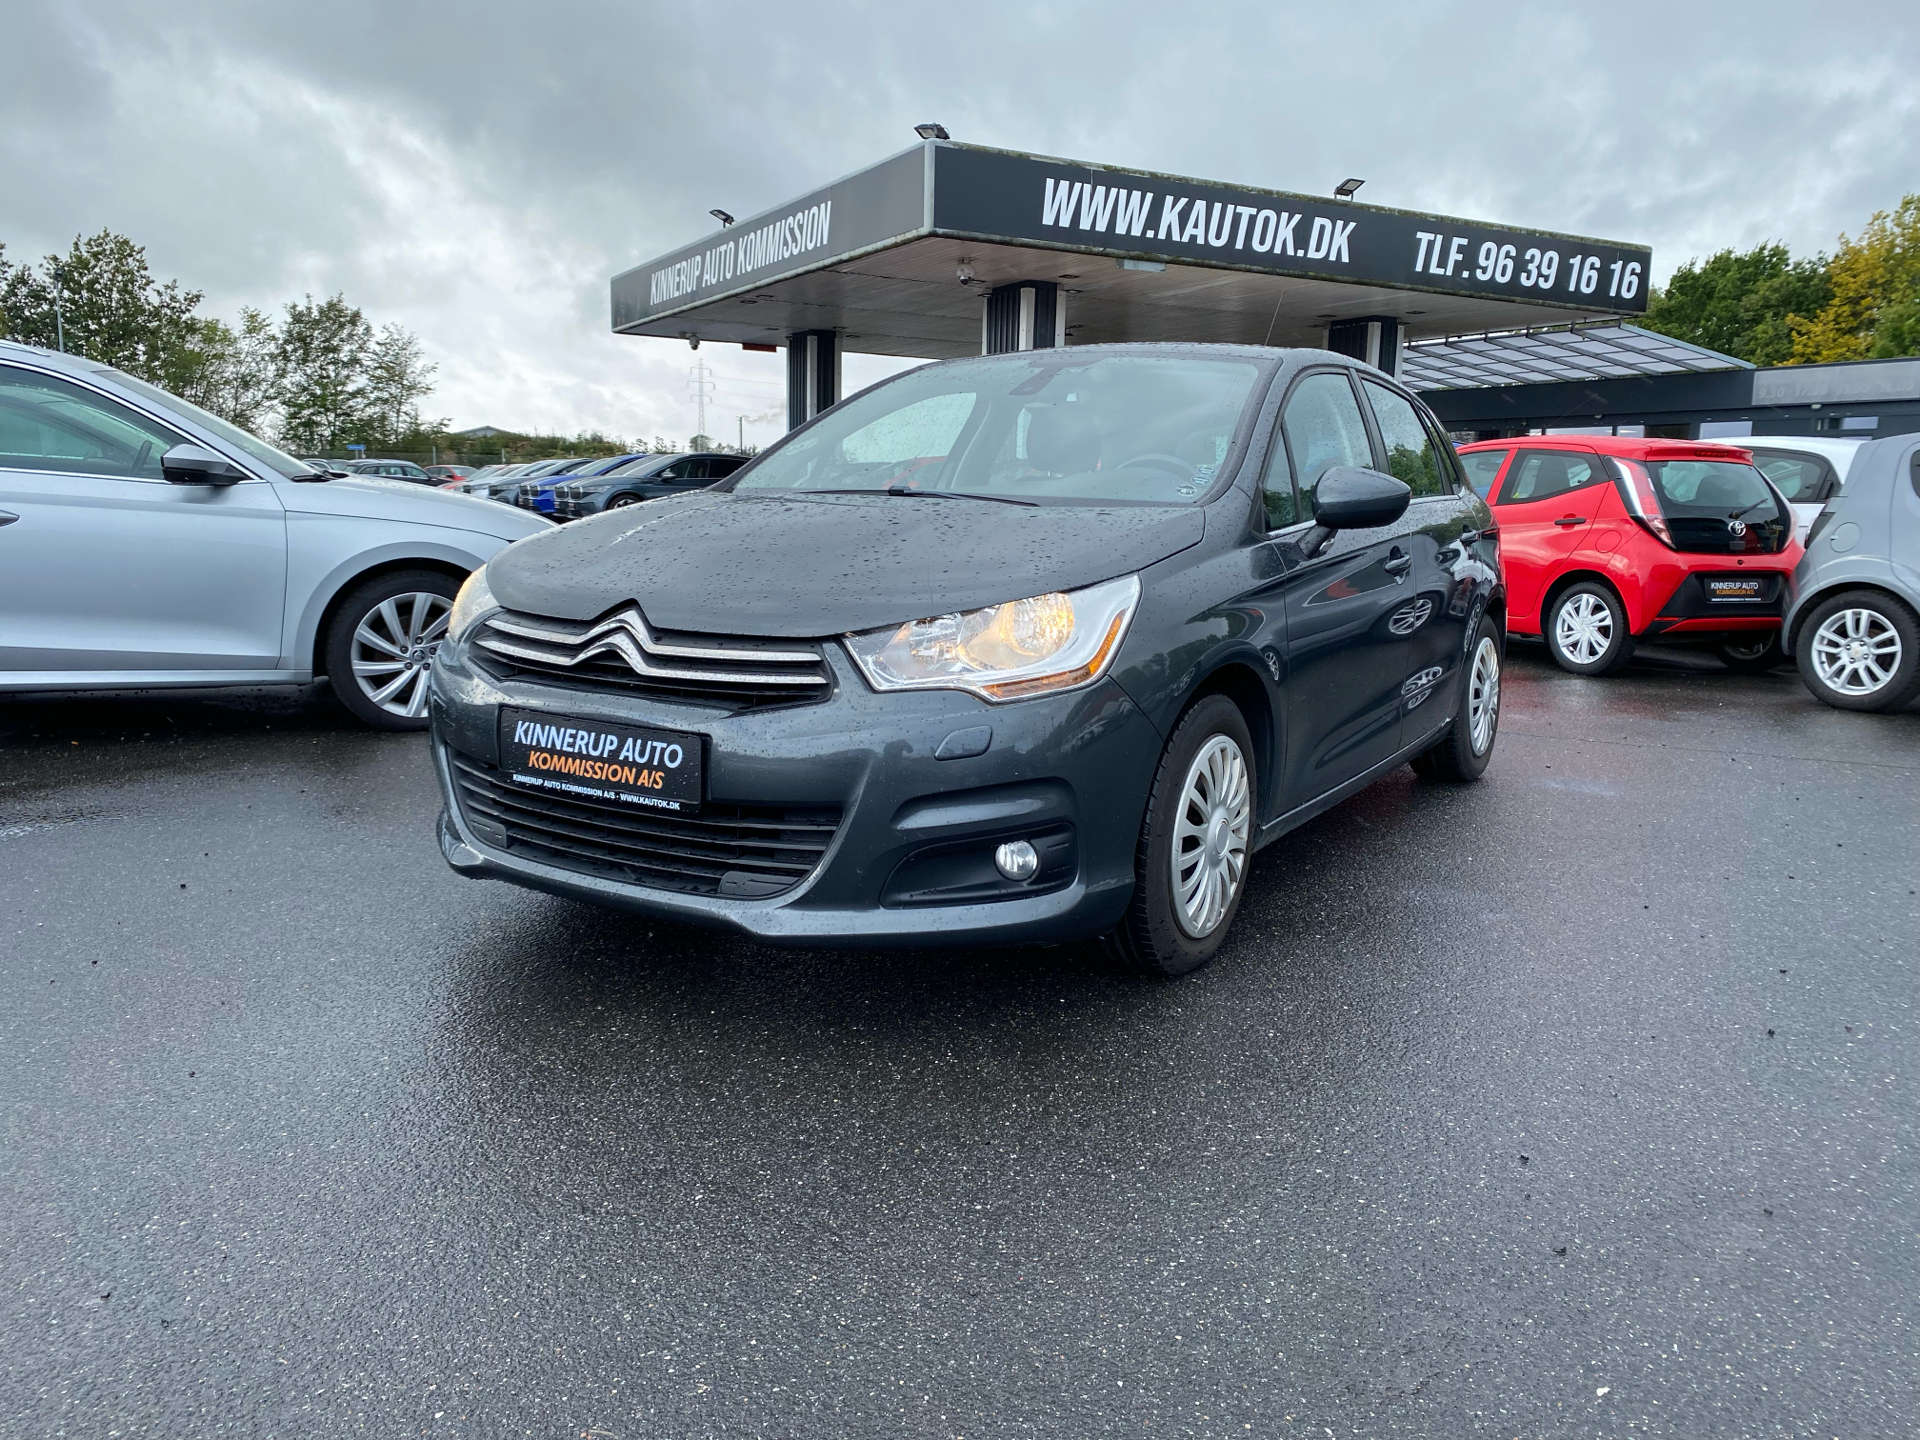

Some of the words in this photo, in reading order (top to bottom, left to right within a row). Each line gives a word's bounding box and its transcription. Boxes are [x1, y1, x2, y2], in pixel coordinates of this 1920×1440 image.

[1042, 178, 1357, 263] WWW.KAUTOK.DK
[650, 254, 702, 306] KINNERUP
[701, 240, 735, 288] AUTO
[736, 201, 832, 276] KOMMISSION
[1414, 231, 1470, 278] TLF.
[1476, 241, 1516, 284] 96
[1520, 247, 1559, 290] 39
[1568, 254, 1601, 294] 16
[1609, 260, 1641, 299] 16
[514, 720, 618, 758] KINNERUP
[619, 737, 683, 769] AUTO
[528, 751, 636, 785] KOMMISSION
[637, 769, 665, 789] A/S
[513, 774, 543, 785] KINNERUP
[544, 779, 561, 789] AUTO
[561, 783, 602, 797] KOMMISSION
[603, 790, 615, 799] A/S
[620, 793, 680, 810] WWW.KAUTOK.DK
